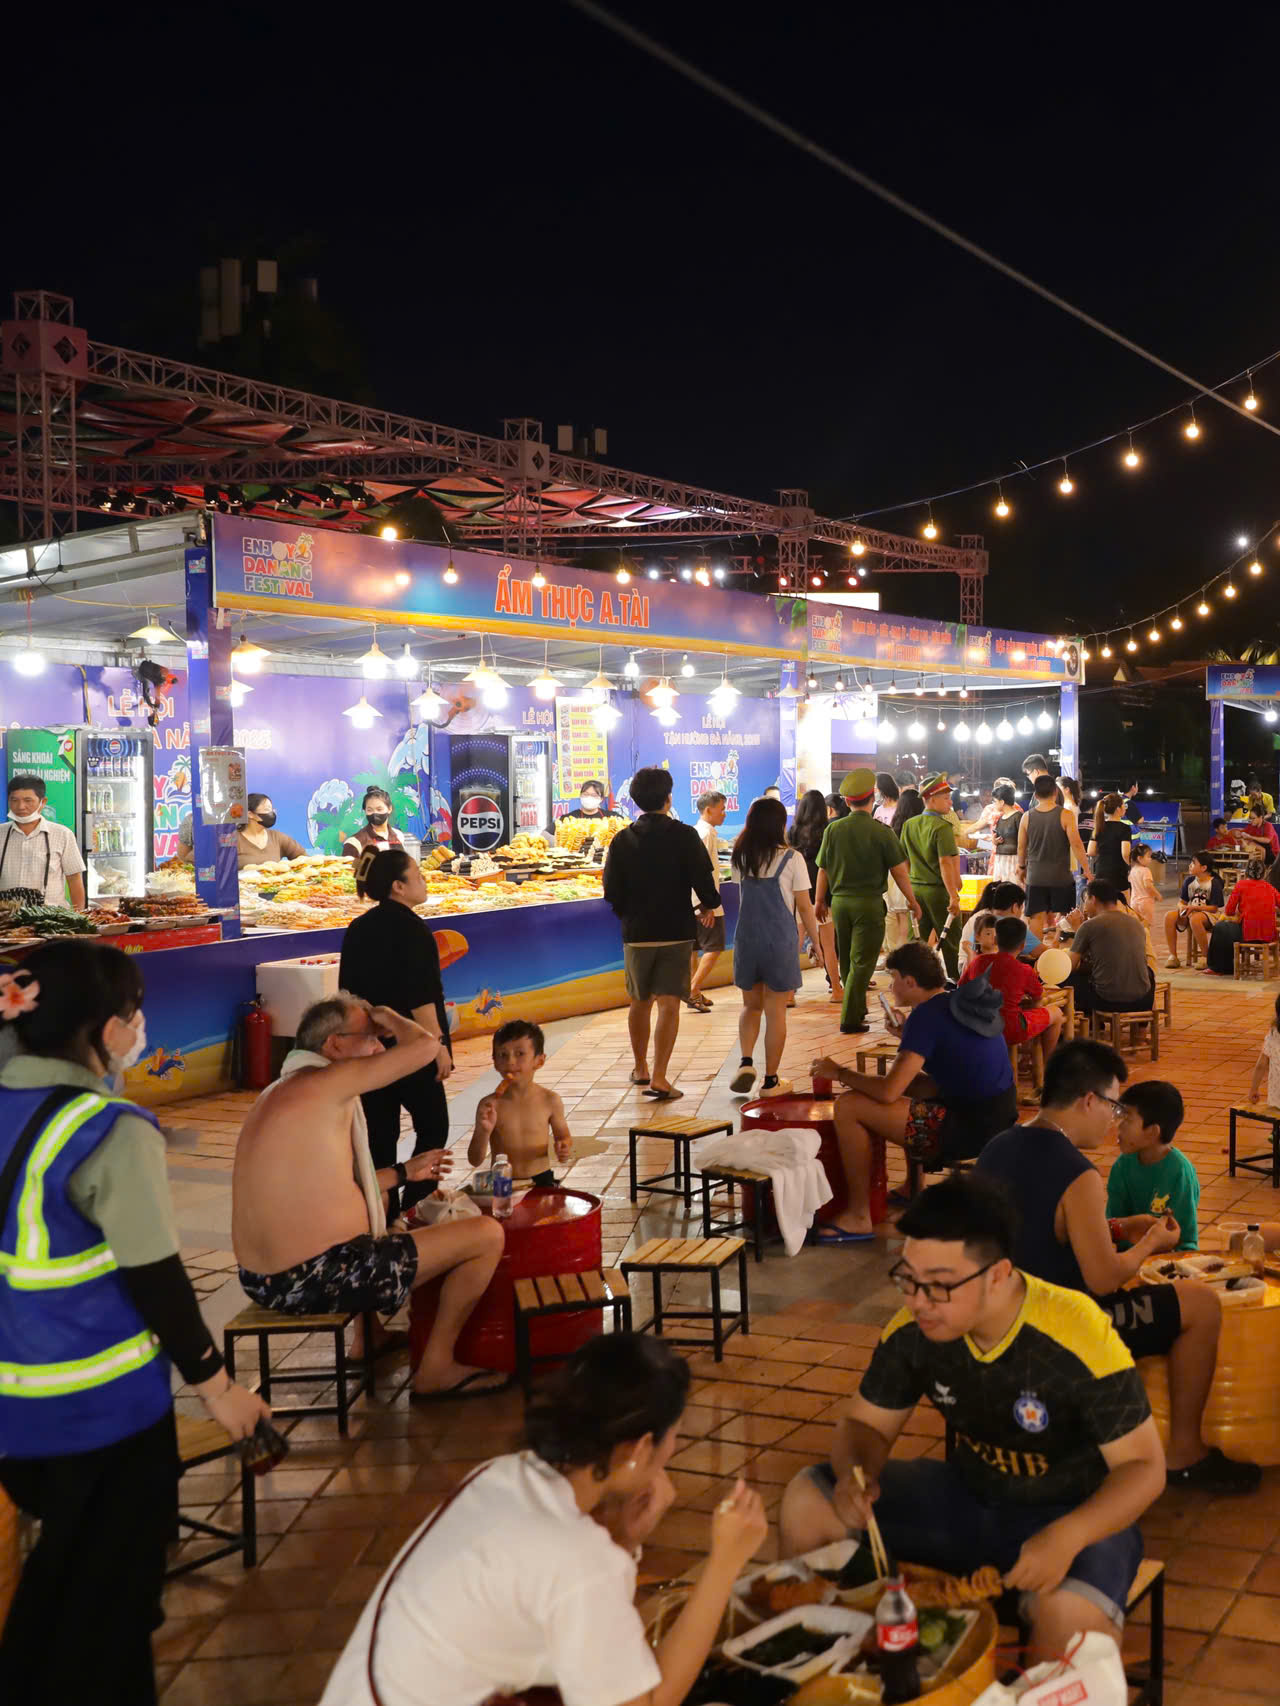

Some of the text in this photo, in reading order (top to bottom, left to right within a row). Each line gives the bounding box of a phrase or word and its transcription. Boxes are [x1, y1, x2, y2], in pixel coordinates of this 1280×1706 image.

[243, 536, 296, 560] ENJOY
[243, 556, 312, 580] DANANG
[244, 574, 314, 598] FESTIVAL
[495, 564, 649, 628] ẨM THỰC A.TÀI
[107, 688, 134, 717] LỄ
[460, 817, 501, 829] PEPSI
